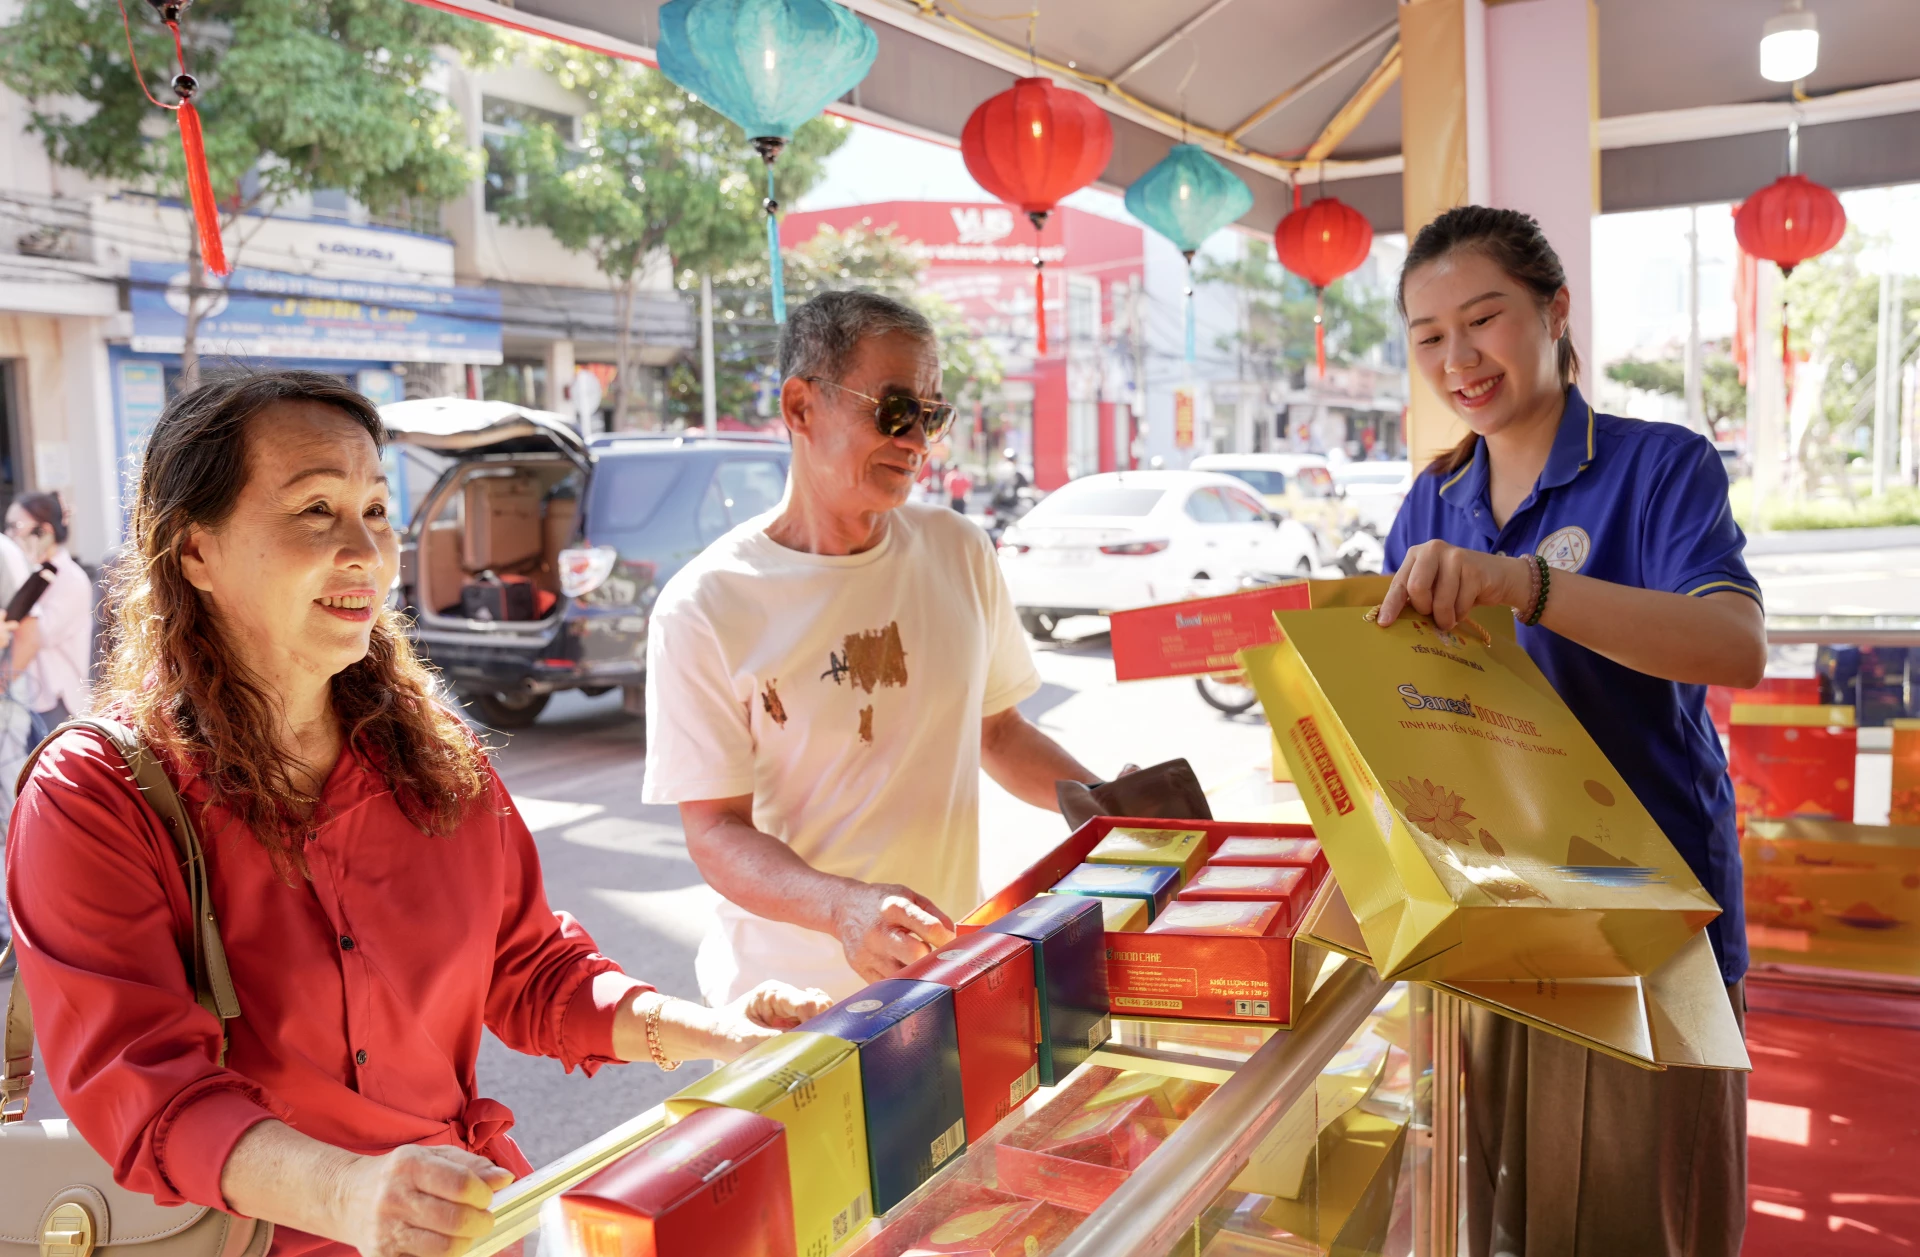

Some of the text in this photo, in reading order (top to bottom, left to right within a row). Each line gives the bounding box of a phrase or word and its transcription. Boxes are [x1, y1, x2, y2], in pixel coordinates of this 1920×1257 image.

[1411, 644, 1430, 654] YẾN
[1398, 683, 1476, 718] Sanest
[1398, 720, 1425, 729] TINH
[1448, 721, 1468, 734] YẾN
[1140, 952, 1162, 963] CAKE
[1210, 977, 1226, 986] KHỐI
[1226, 979, 1249, 988] LƯỢNG
[1169, 1000, 1180, 1008] 222
